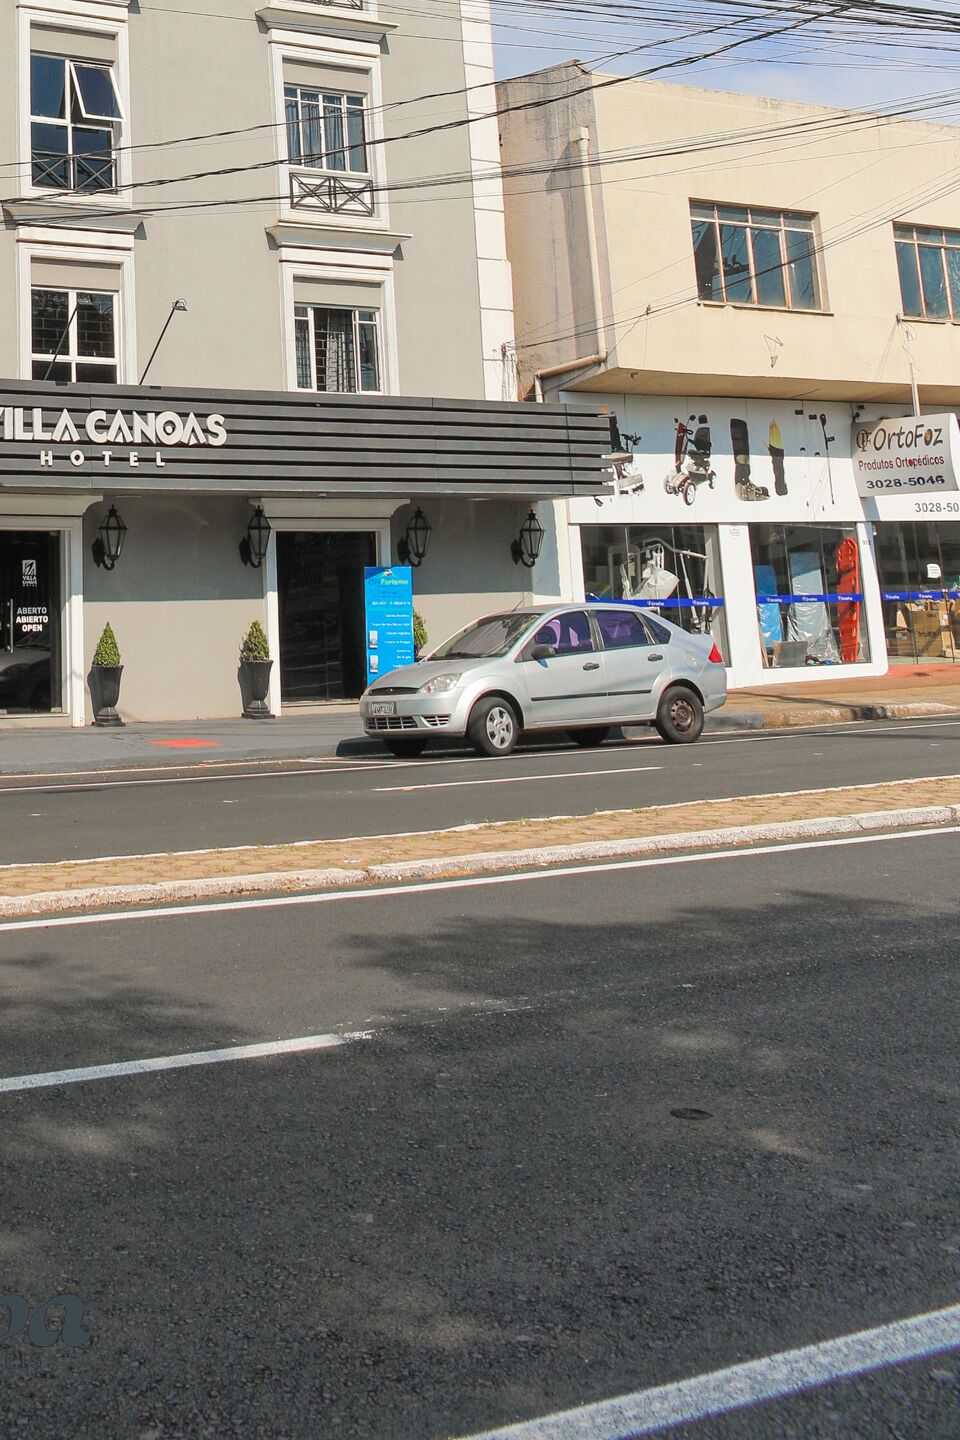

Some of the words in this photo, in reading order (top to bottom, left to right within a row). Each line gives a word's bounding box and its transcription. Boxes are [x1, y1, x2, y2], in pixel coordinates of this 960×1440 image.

[85, 409, 228, 446] CANOAS
[873, 424, 944, 451] OrtoFoz
[40, 449, 166, 468] HOTEL
[858, 459, 894, 471] Produtos
[895, 454, 945, 470] Ortopédicos
[16, 615, 49, 624] ABIERTO
[17, 607, 47, 615] ABERTO
[22, 624, 43, 632] OPEN
